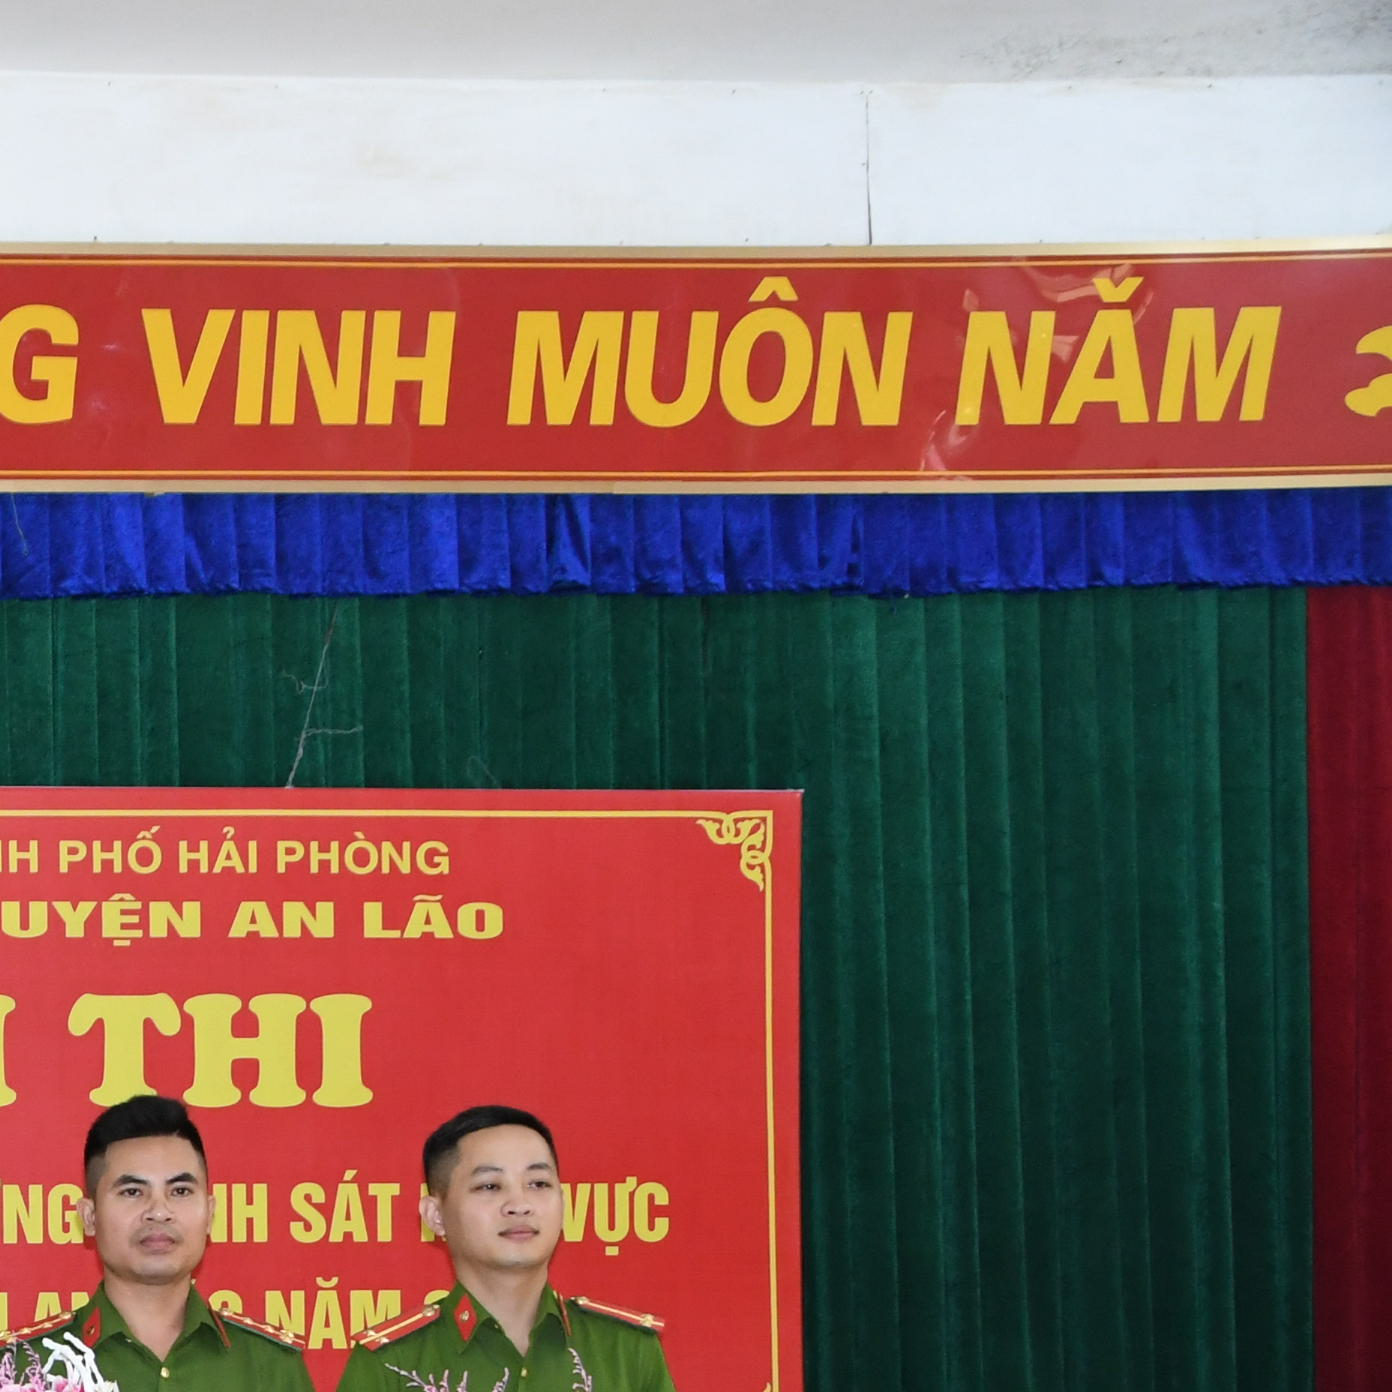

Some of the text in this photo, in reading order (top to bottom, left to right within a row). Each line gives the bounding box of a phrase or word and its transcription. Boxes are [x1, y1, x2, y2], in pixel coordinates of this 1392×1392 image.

[141, 308, 457, 427] VINH
[507, 276, 912, 429] MUÔN
[956, 276, 1283, 425] NĂM
[58, 825, 162, 875] PHỐ
[177, 826, 259, 876] HẢI
[276, 828, 451, 876] PHÒNG
[227, 900, 336, 939] AN
[362, 893, 505, 941] LÃO
[66, 992, 375, 1108] THI
[289, 1169, 401, 1244] SÁT
[561, 1175, 670, 1256] VỰC
[264, 1275, 402, 1350] NĂM
